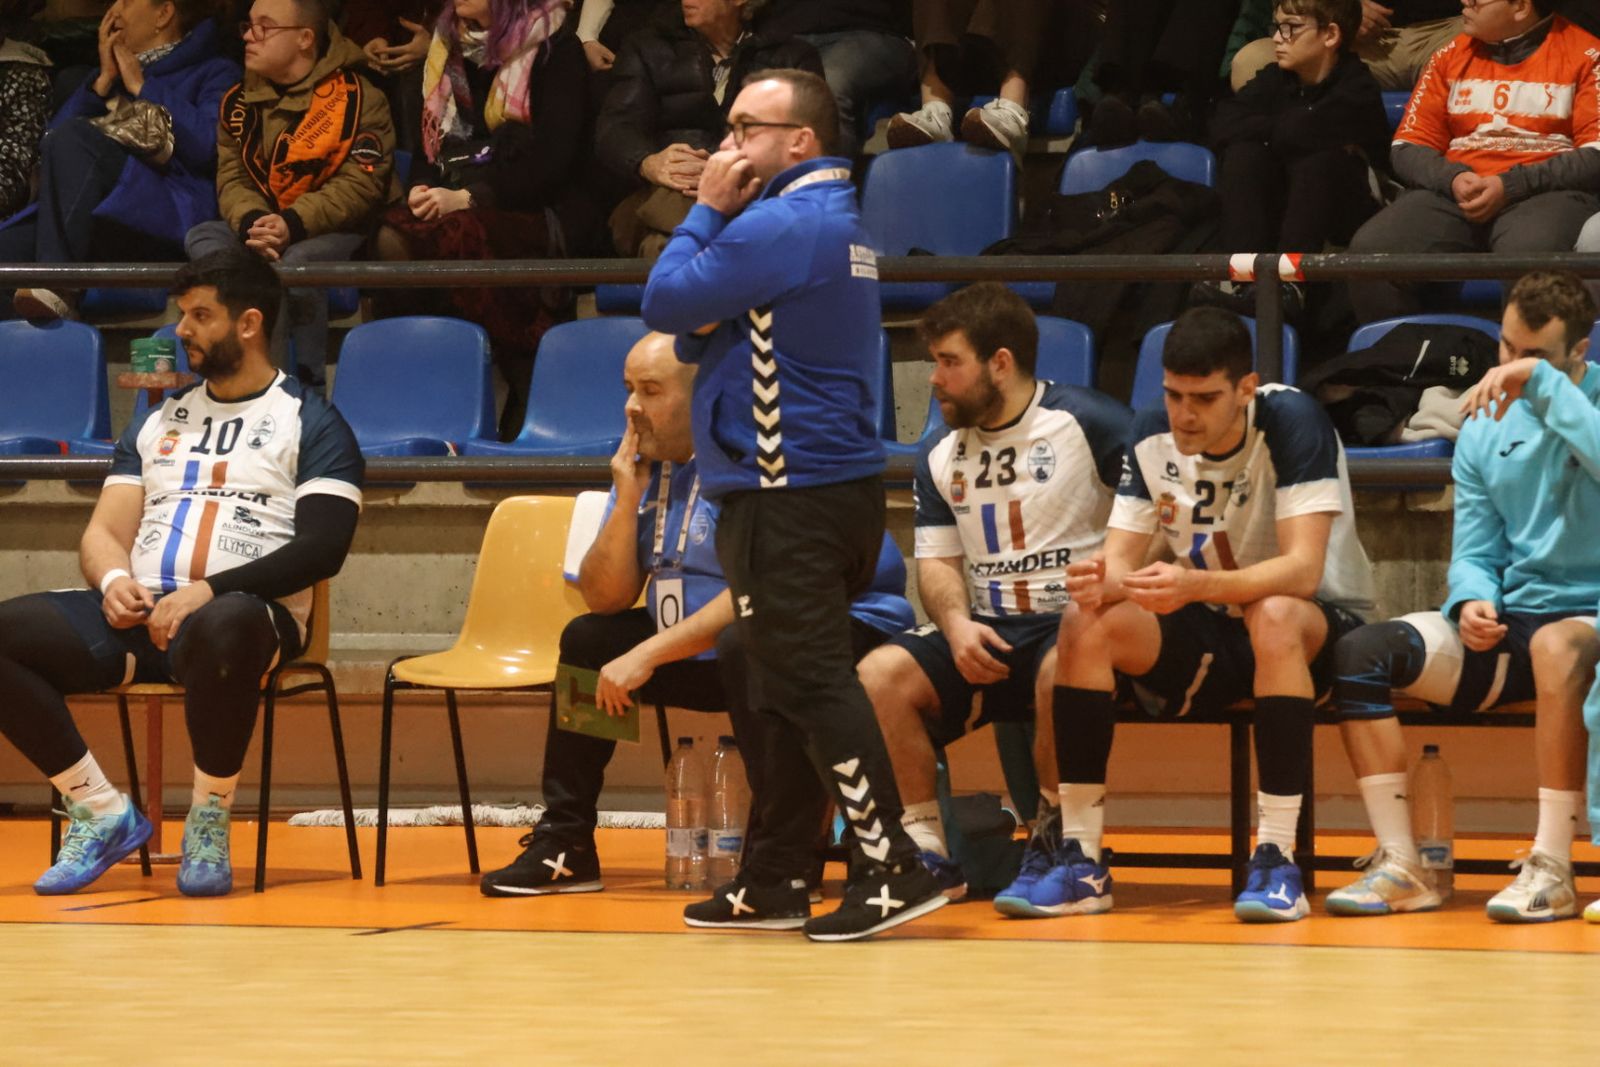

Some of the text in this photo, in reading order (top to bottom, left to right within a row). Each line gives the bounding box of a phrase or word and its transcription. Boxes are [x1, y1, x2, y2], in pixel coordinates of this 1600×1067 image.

[1493, 83, 1511, 111] 6
[190, 416, 244, 455] 10
[974, 446, 1017, 489] 23
[218, 536, 260, 560] FLYMCA
